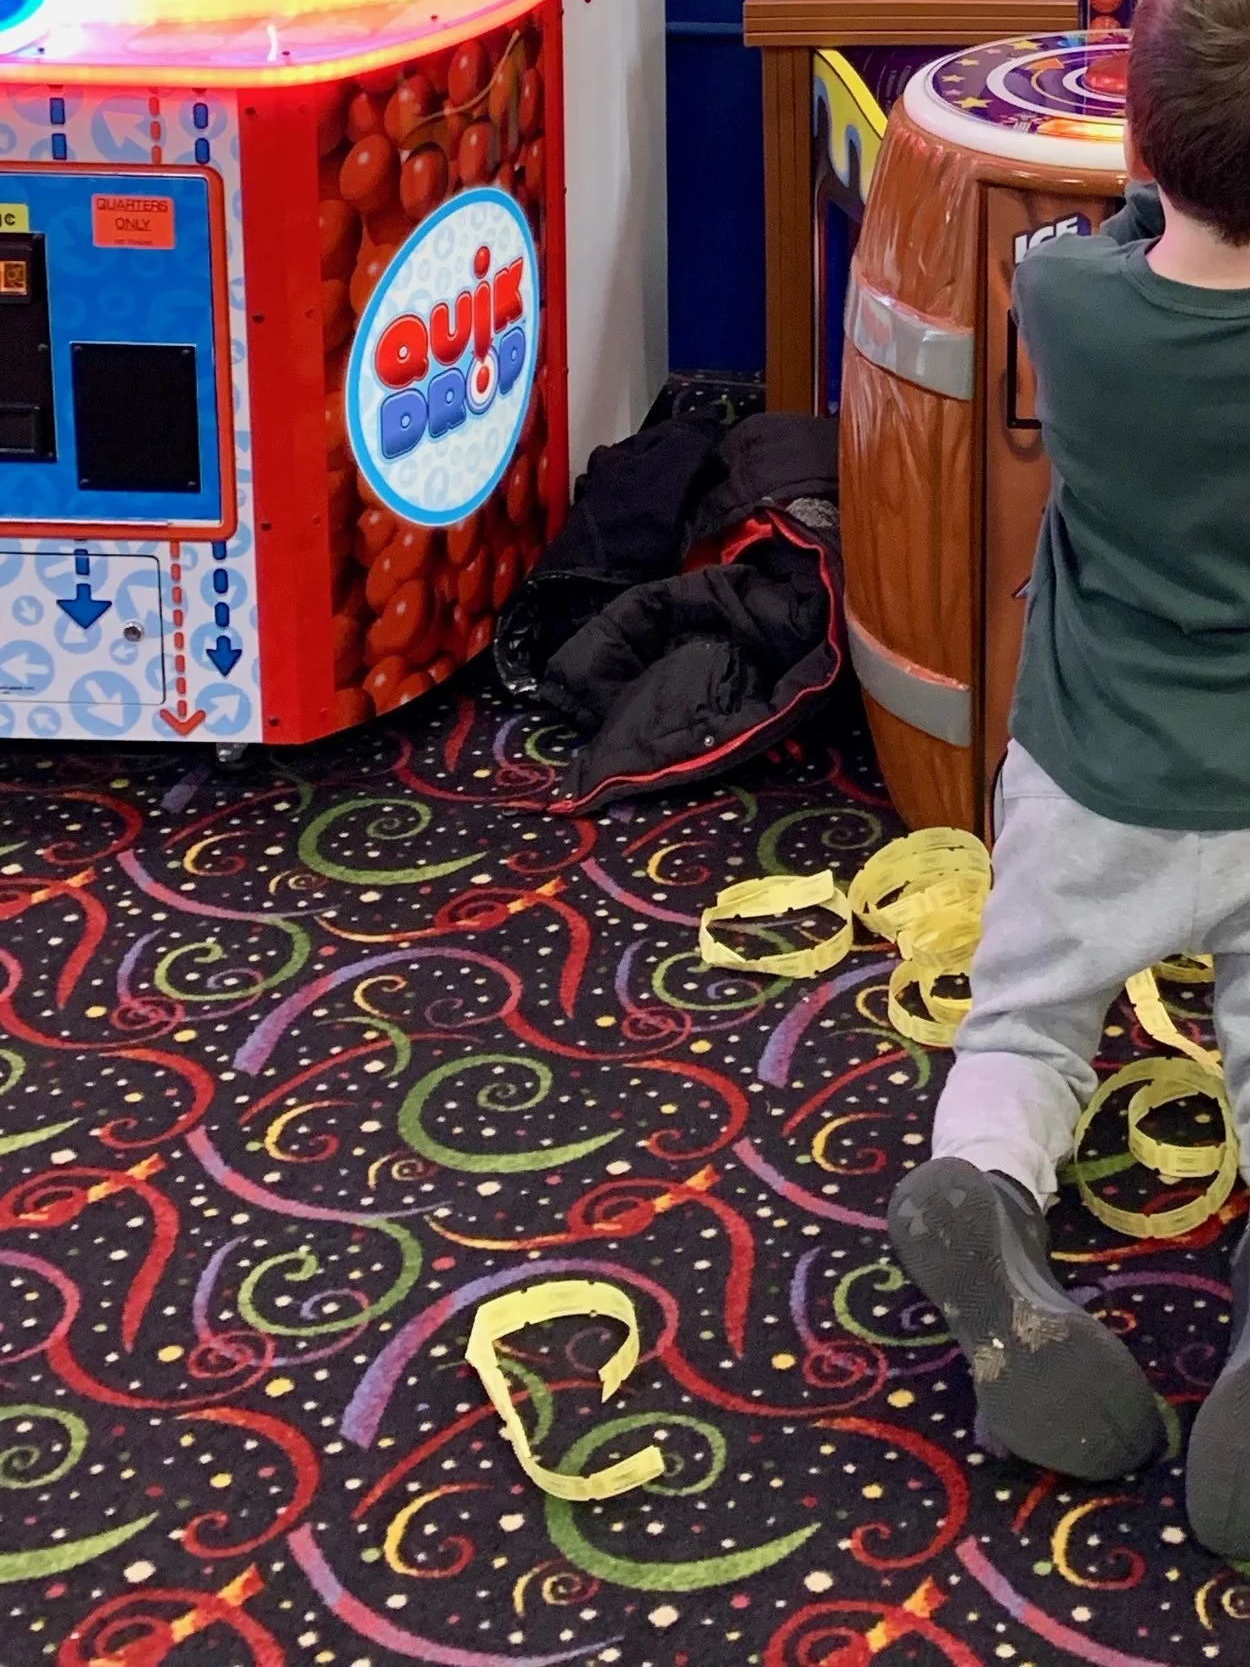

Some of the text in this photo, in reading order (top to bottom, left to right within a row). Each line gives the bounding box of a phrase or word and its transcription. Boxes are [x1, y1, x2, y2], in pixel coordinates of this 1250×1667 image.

[96, 197, 169, 213] QUARTERS
[115, 217, 151, 232] ONLY
[380, 326, 527, 460] DROP
